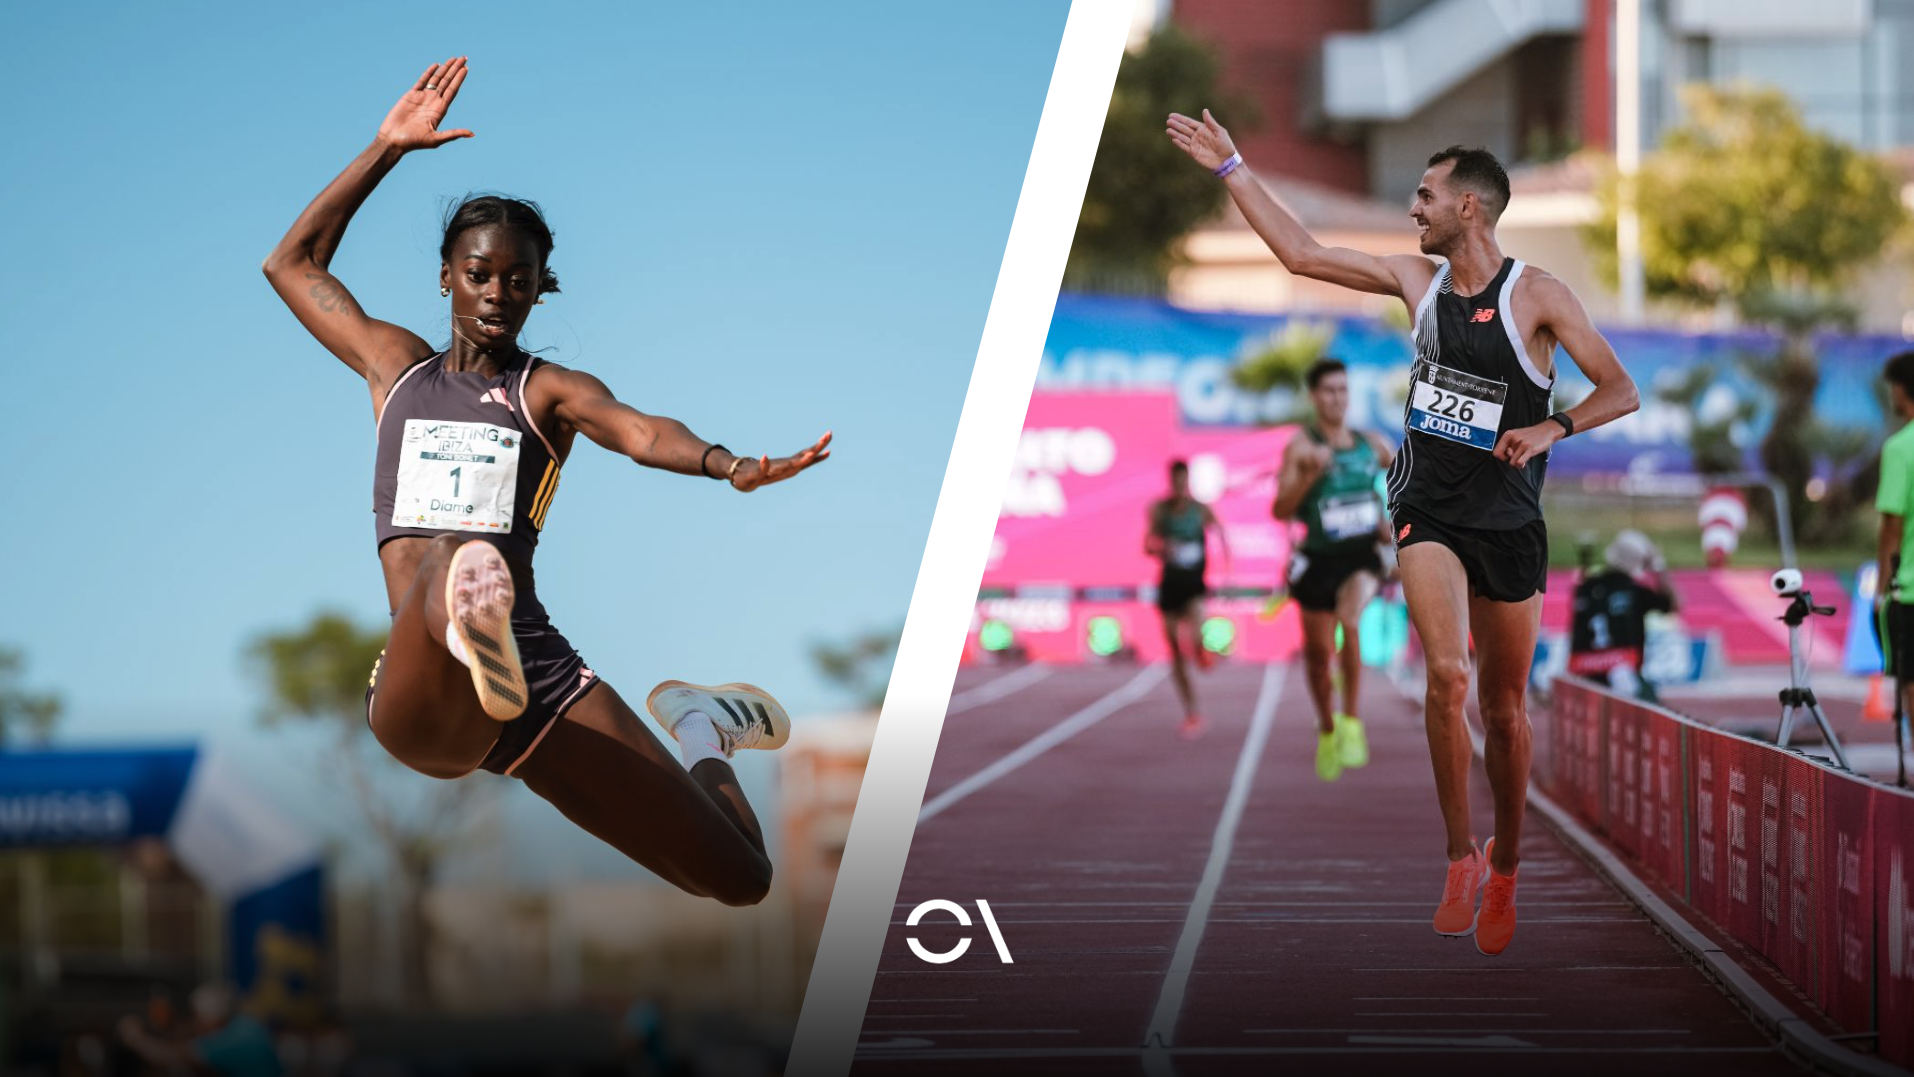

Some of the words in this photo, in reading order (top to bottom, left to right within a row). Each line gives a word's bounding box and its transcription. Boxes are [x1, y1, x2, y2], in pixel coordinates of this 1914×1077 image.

[1427, 390, 1476, 422] 226
[422, 424, 499, 442] MEETING
[438, 440, 473, 453] IBIZA
[449, 466, 462, 498] 1
[430, 498, 474, 514] Diame
